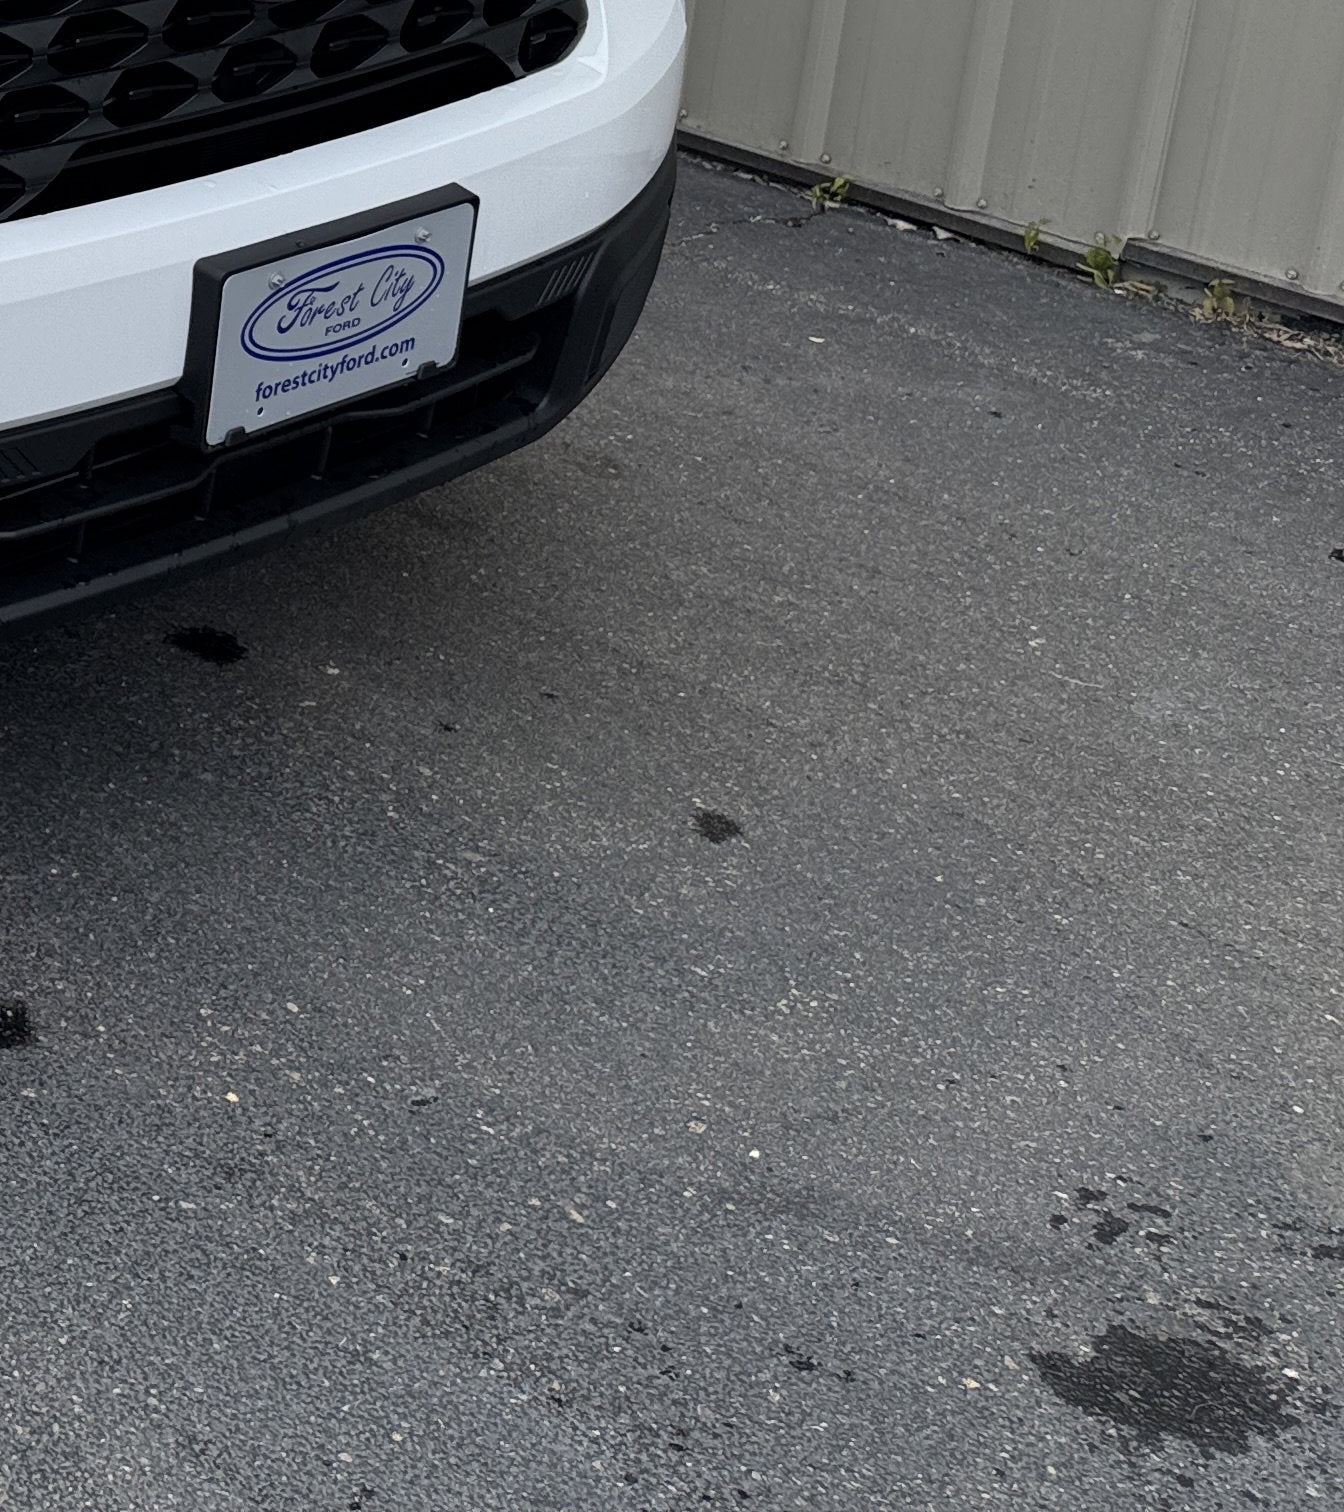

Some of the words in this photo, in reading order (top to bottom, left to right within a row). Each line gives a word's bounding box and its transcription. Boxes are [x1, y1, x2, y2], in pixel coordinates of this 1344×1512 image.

[277, 280, 364, 334] Forest
[370, 264, 415, 313] City
[324, 317, 361, 337] FORD
[255, 336, 416, 402] forestcityford.com
